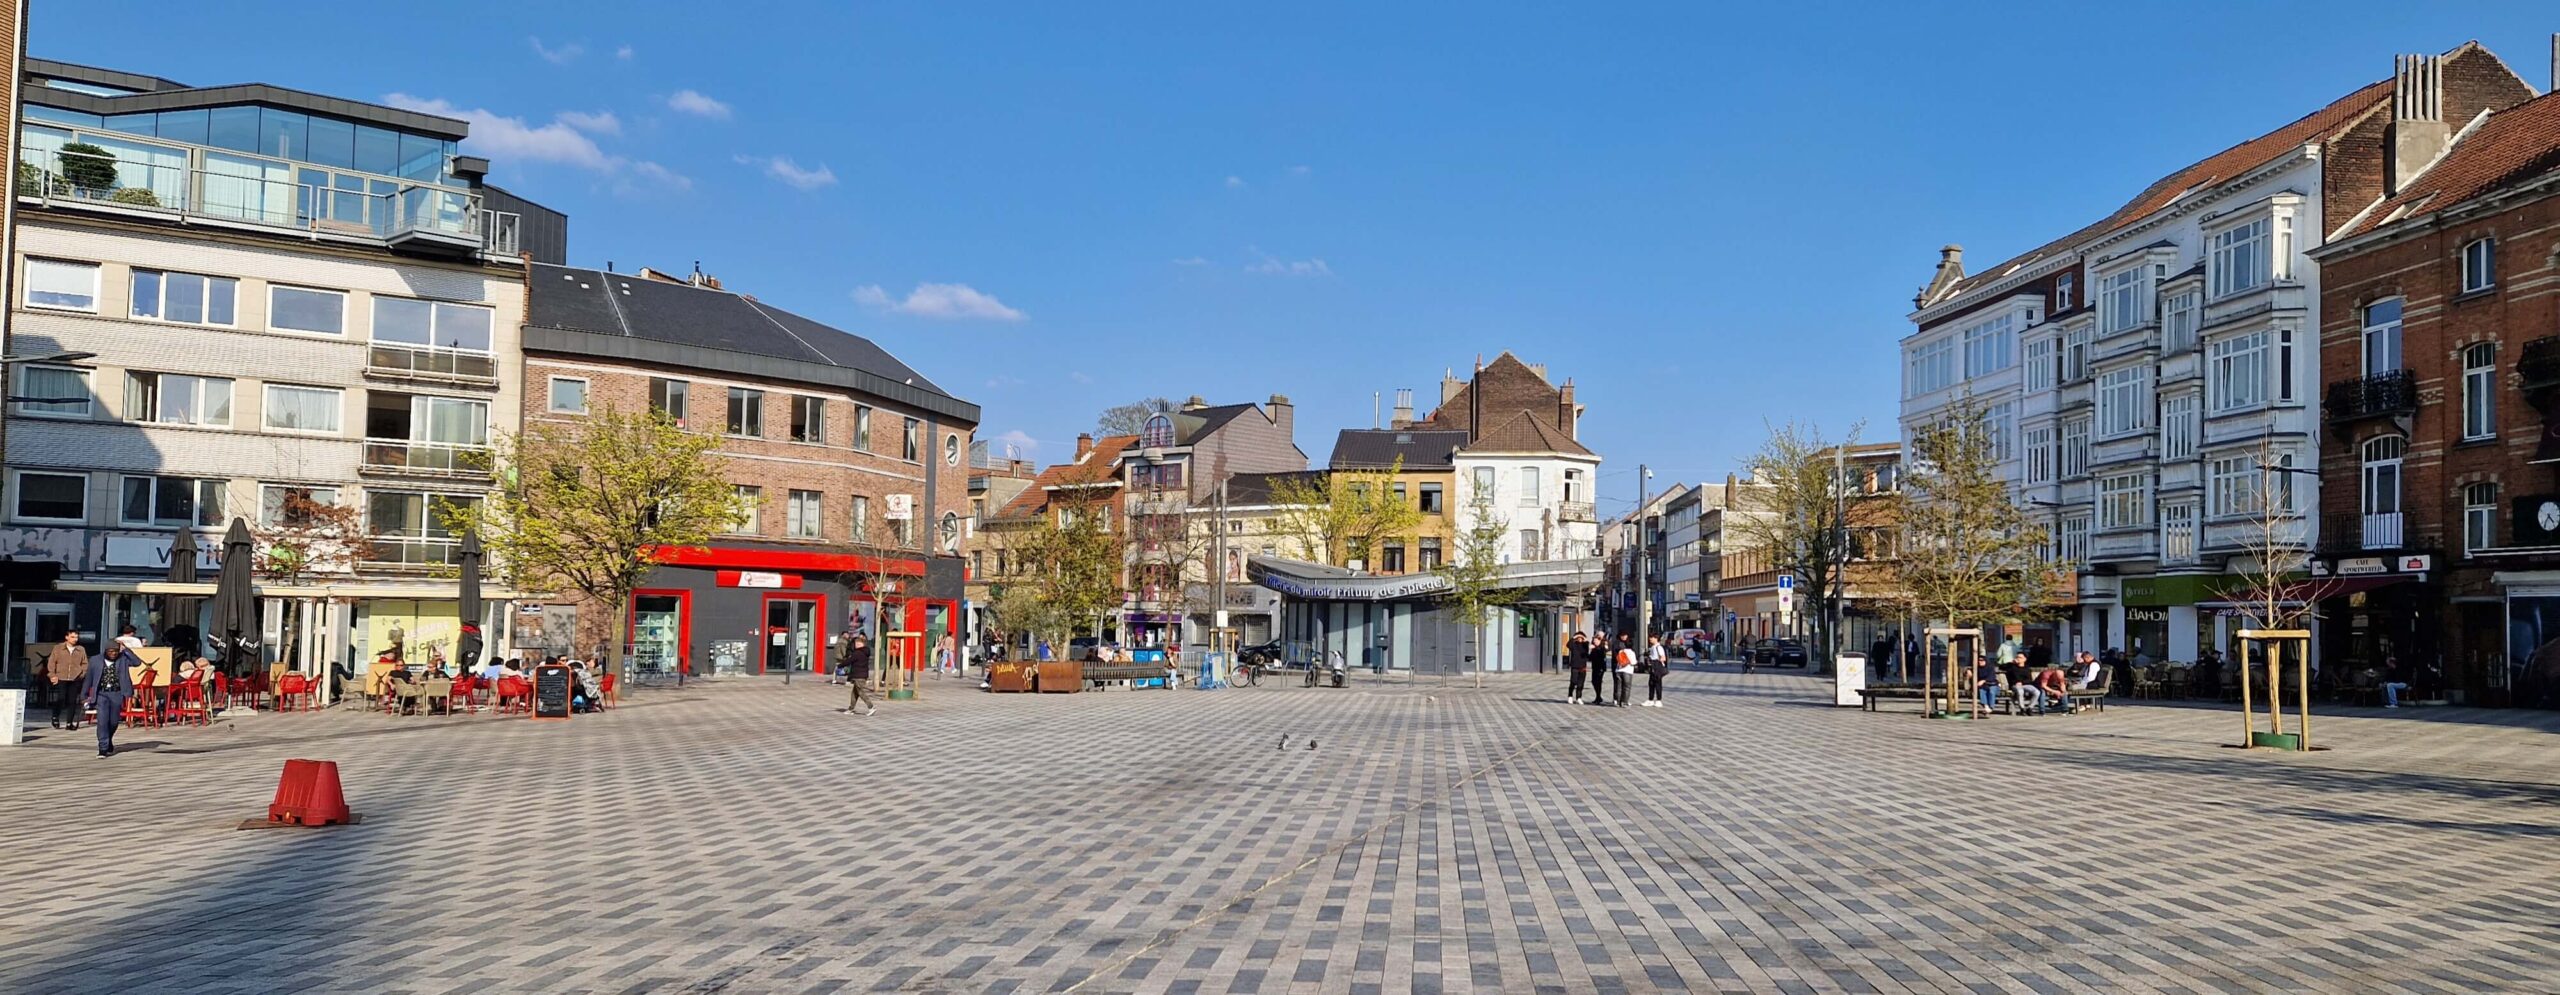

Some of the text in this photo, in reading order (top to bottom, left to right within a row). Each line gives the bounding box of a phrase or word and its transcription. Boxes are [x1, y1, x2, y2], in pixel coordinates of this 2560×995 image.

[1302, 586, 1332, 598] miroir
[1336, 585, 1375, 598] Frituur
[1379, 585, 1395, 598] de
[2234, 608, 2281, 617] SPOTWERLD
